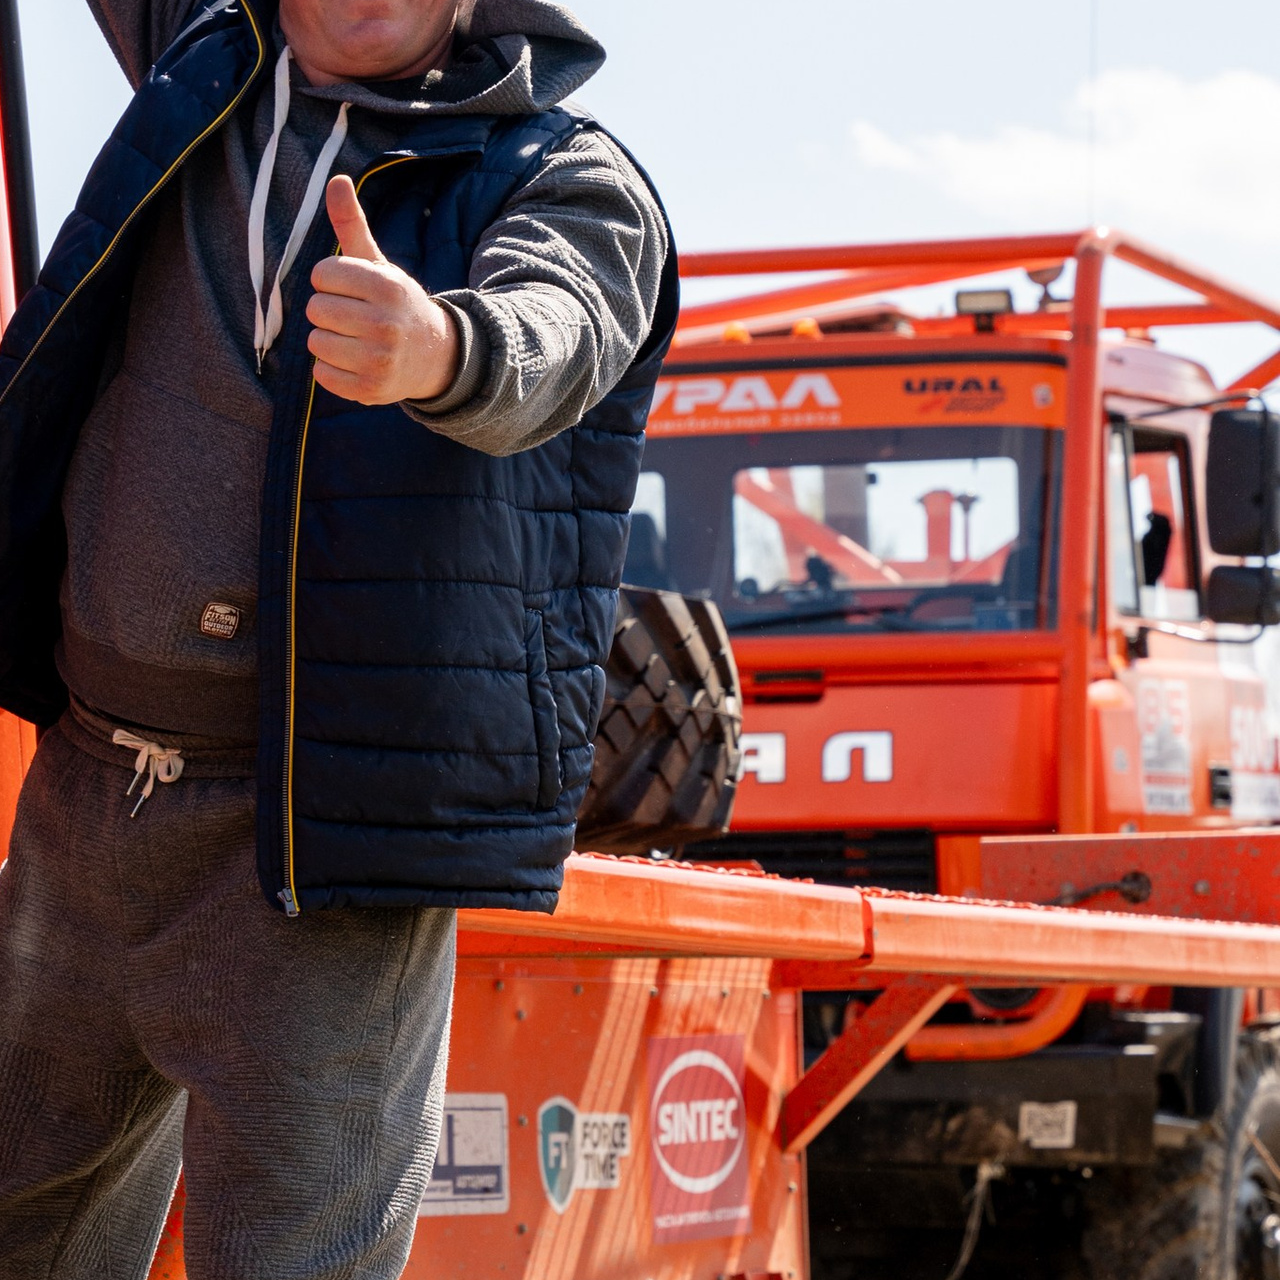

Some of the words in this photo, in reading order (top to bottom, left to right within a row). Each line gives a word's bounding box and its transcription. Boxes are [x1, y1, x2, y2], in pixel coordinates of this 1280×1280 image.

[582, 1121, 627, 1149] FORCE
[658, 1097, 739, 1146] SINTEC
[583, 1152, 617, 1180] TIME
